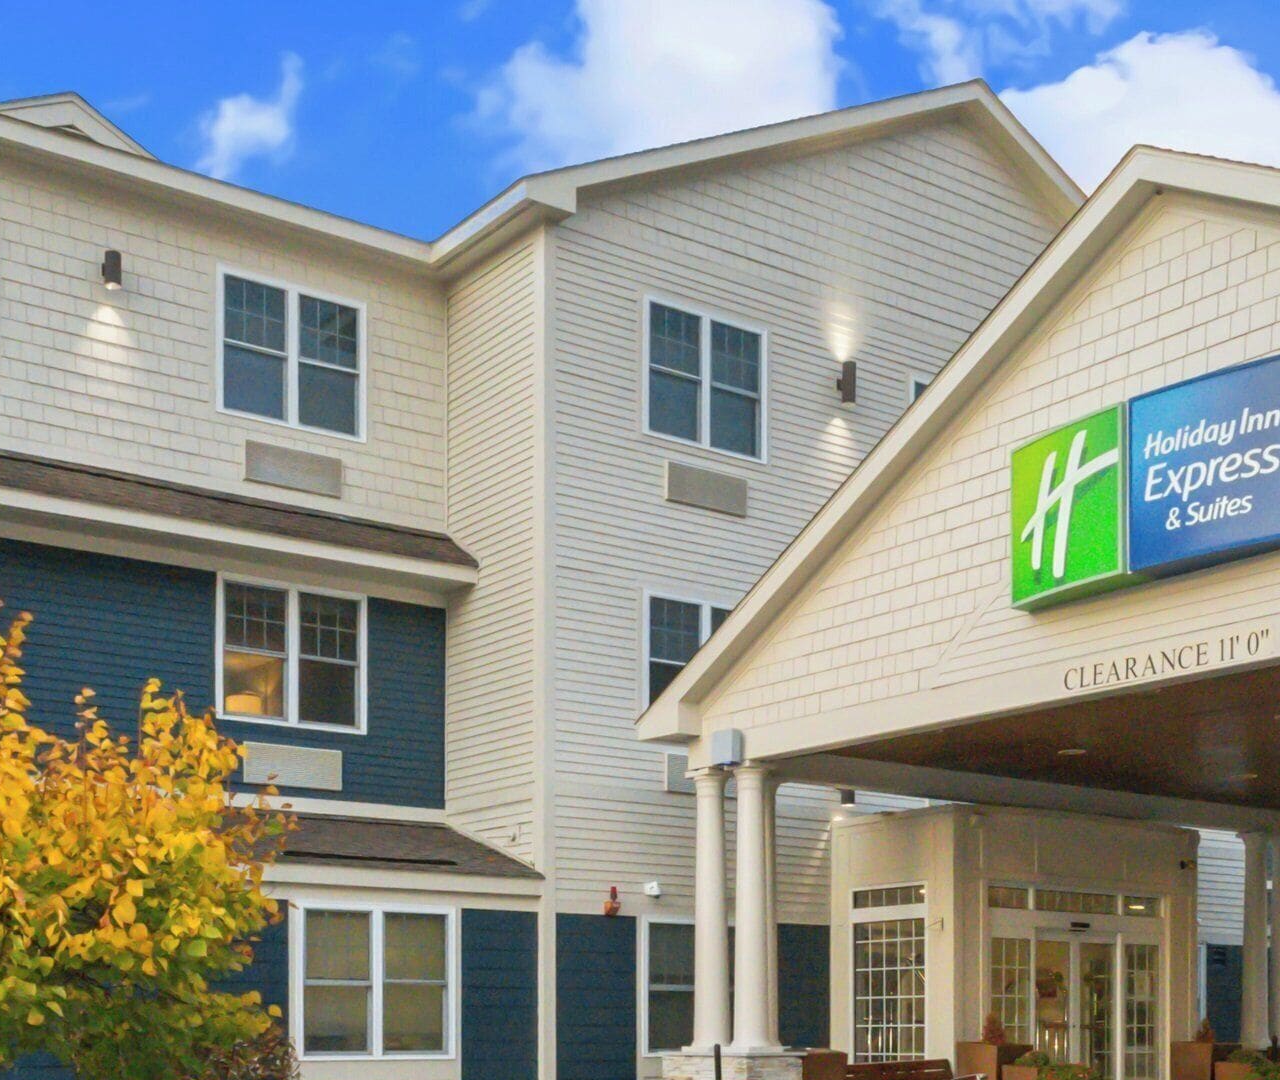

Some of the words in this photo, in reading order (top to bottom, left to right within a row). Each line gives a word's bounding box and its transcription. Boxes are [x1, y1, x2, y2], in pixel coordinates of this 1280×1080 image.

[1144, 418, 1236, 460] Holiday
[1165, 506, 1181, 531] &
[1185, 495, 1253, 526] Suites
[1063, 641, 1209, 691] CLEARANCE
[1220, 634, 1240, 662] 11'
